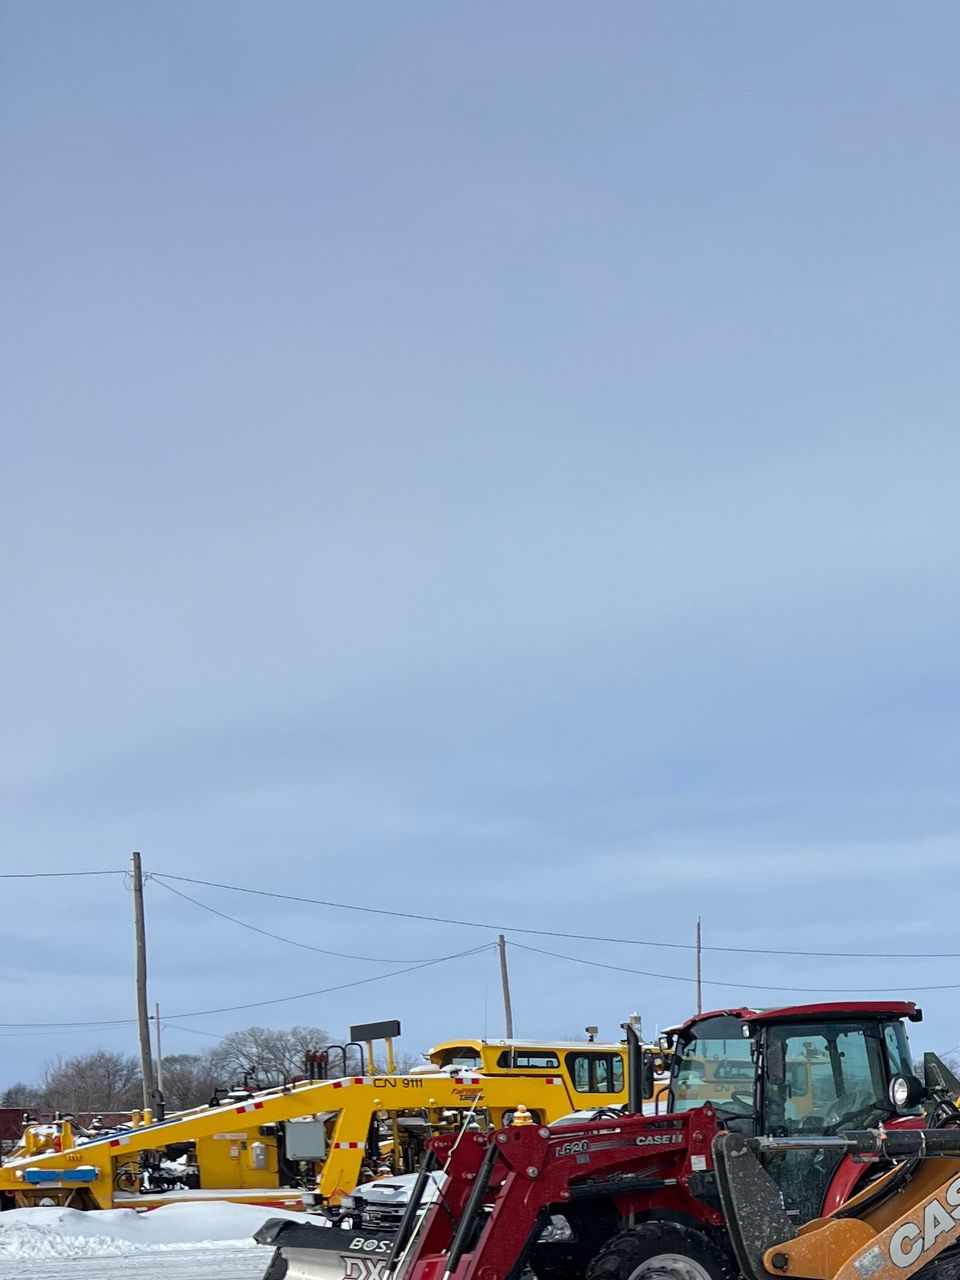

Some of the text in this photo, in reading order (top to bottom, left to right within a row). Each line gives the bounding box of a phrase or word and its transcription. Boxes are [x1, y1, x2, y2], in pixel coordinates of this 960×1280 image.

[373, 1078, 423, 1088] CN 9111
[635, 1135, 671, 1146] CASE
